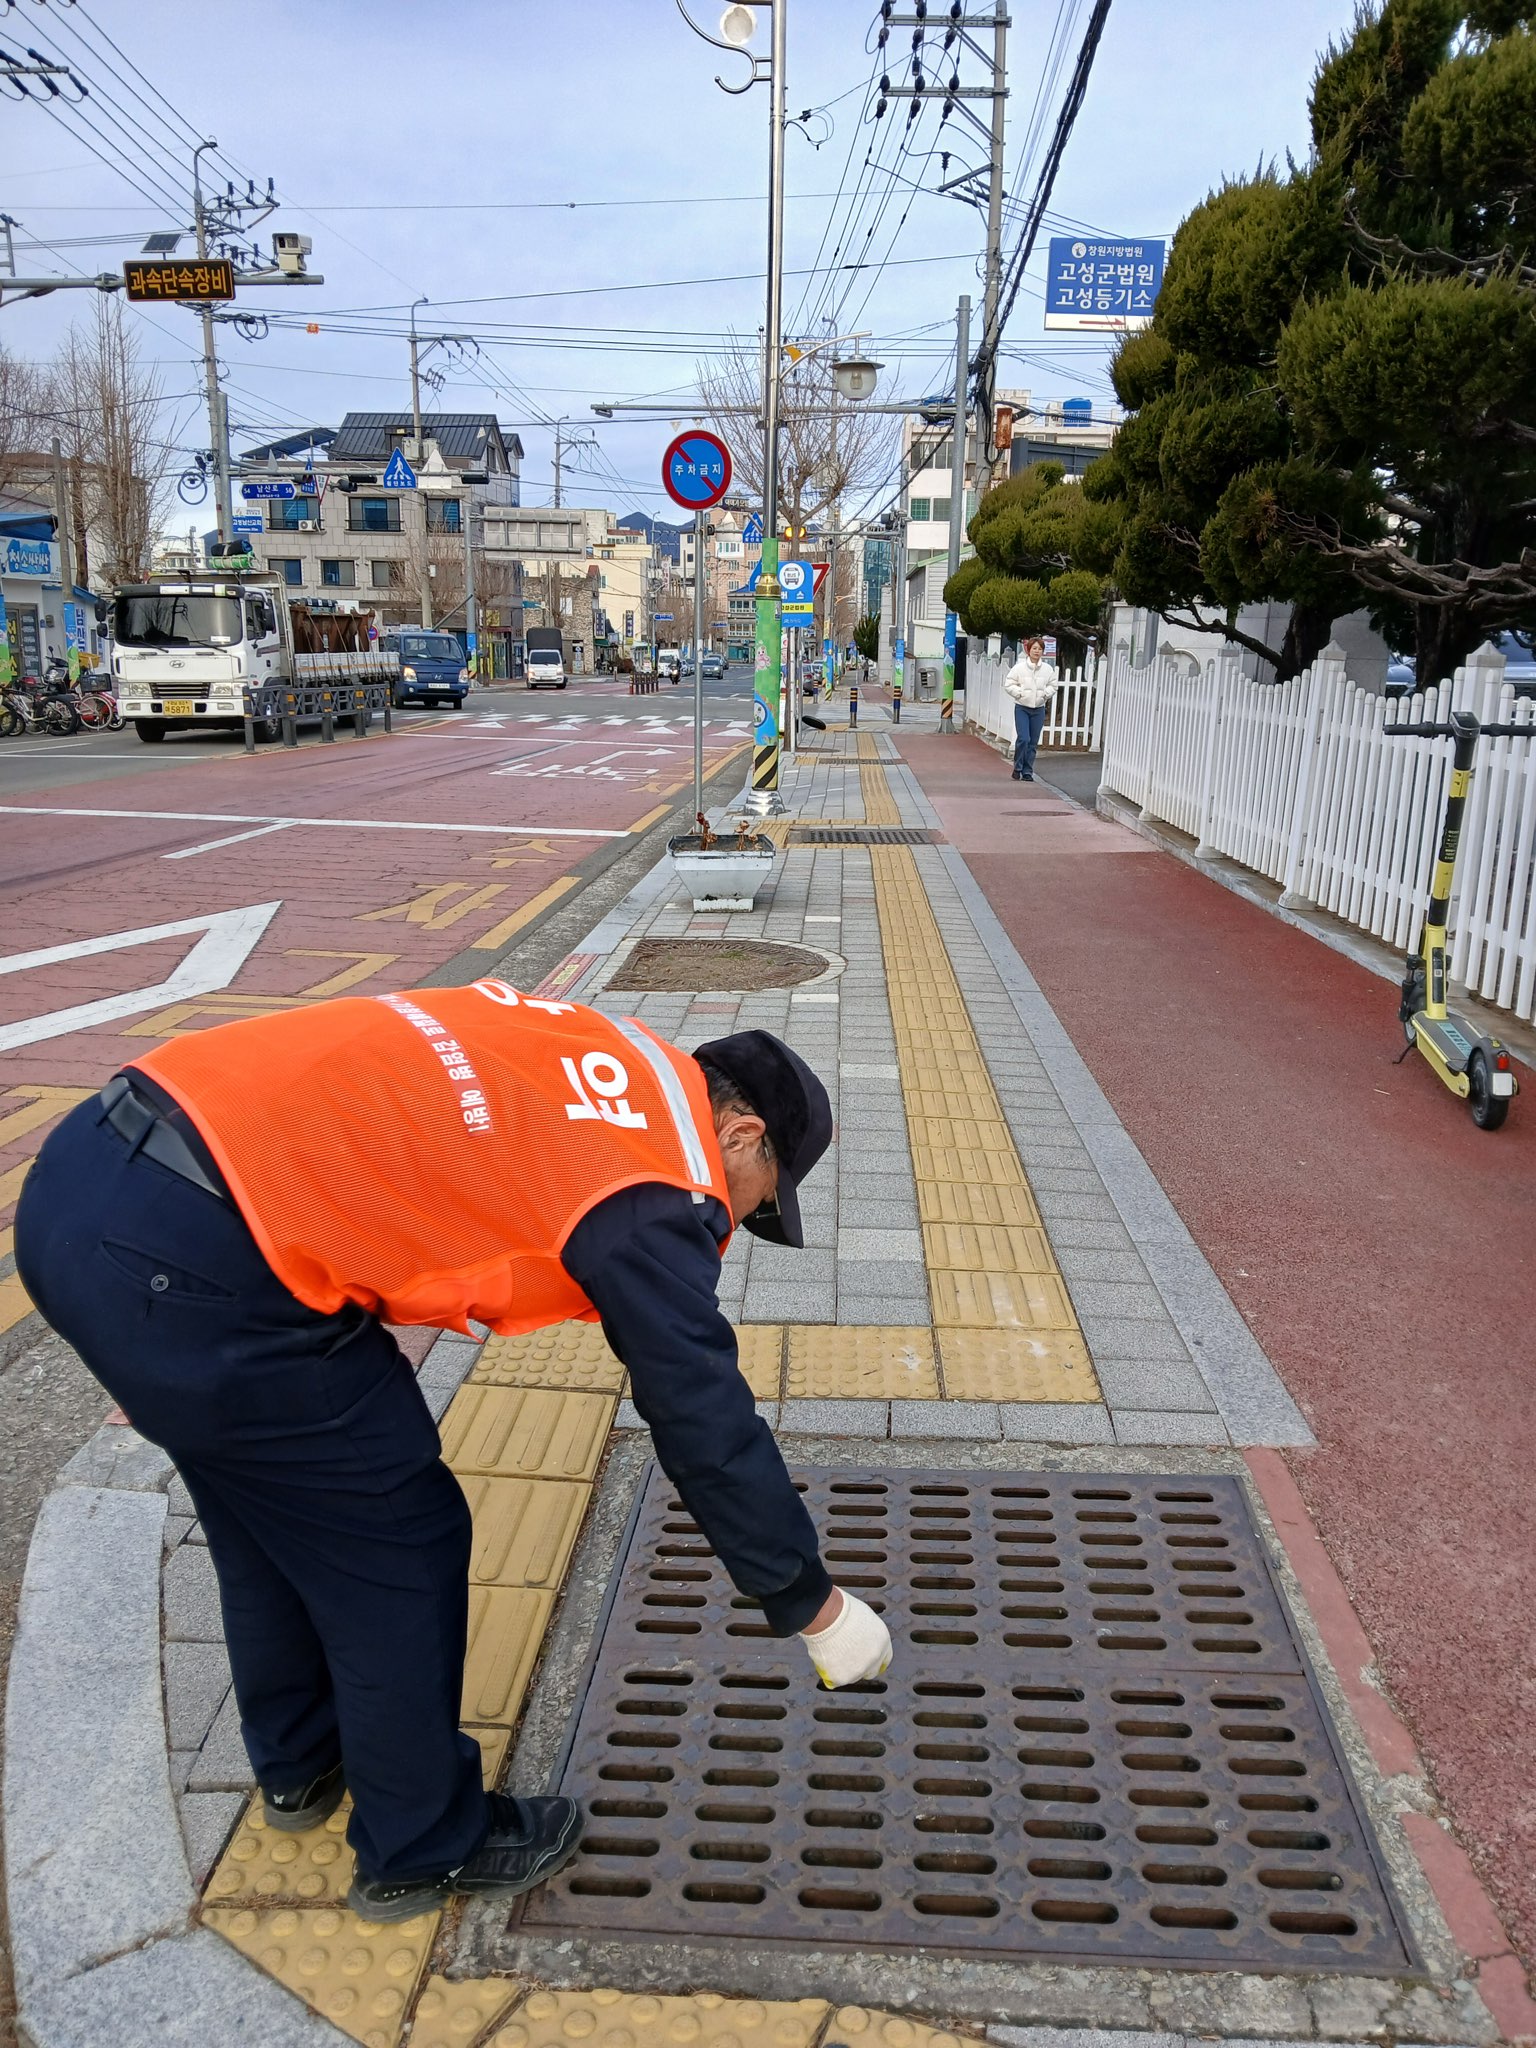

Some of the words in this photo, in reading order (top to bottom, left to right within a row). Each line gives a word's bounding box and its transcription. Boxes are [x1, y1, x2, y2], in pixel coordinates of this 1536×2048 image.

[1088, 245, 1143, 258] 창원지방법원
[130, 266, 228, 295] 과속단속장비
[1057, 262, 1154, 286] 고성군법원
[1055, 288, 1152, 310] 고성등기소
[675, 463, 721, 476] 주차금지
[256, 485, 279, 493] 남산로
[171, 705, 190, 714] 5871
[432, 1039, 476, 1081] 감염병
[460, 1089, 491, 1134] 예방!
